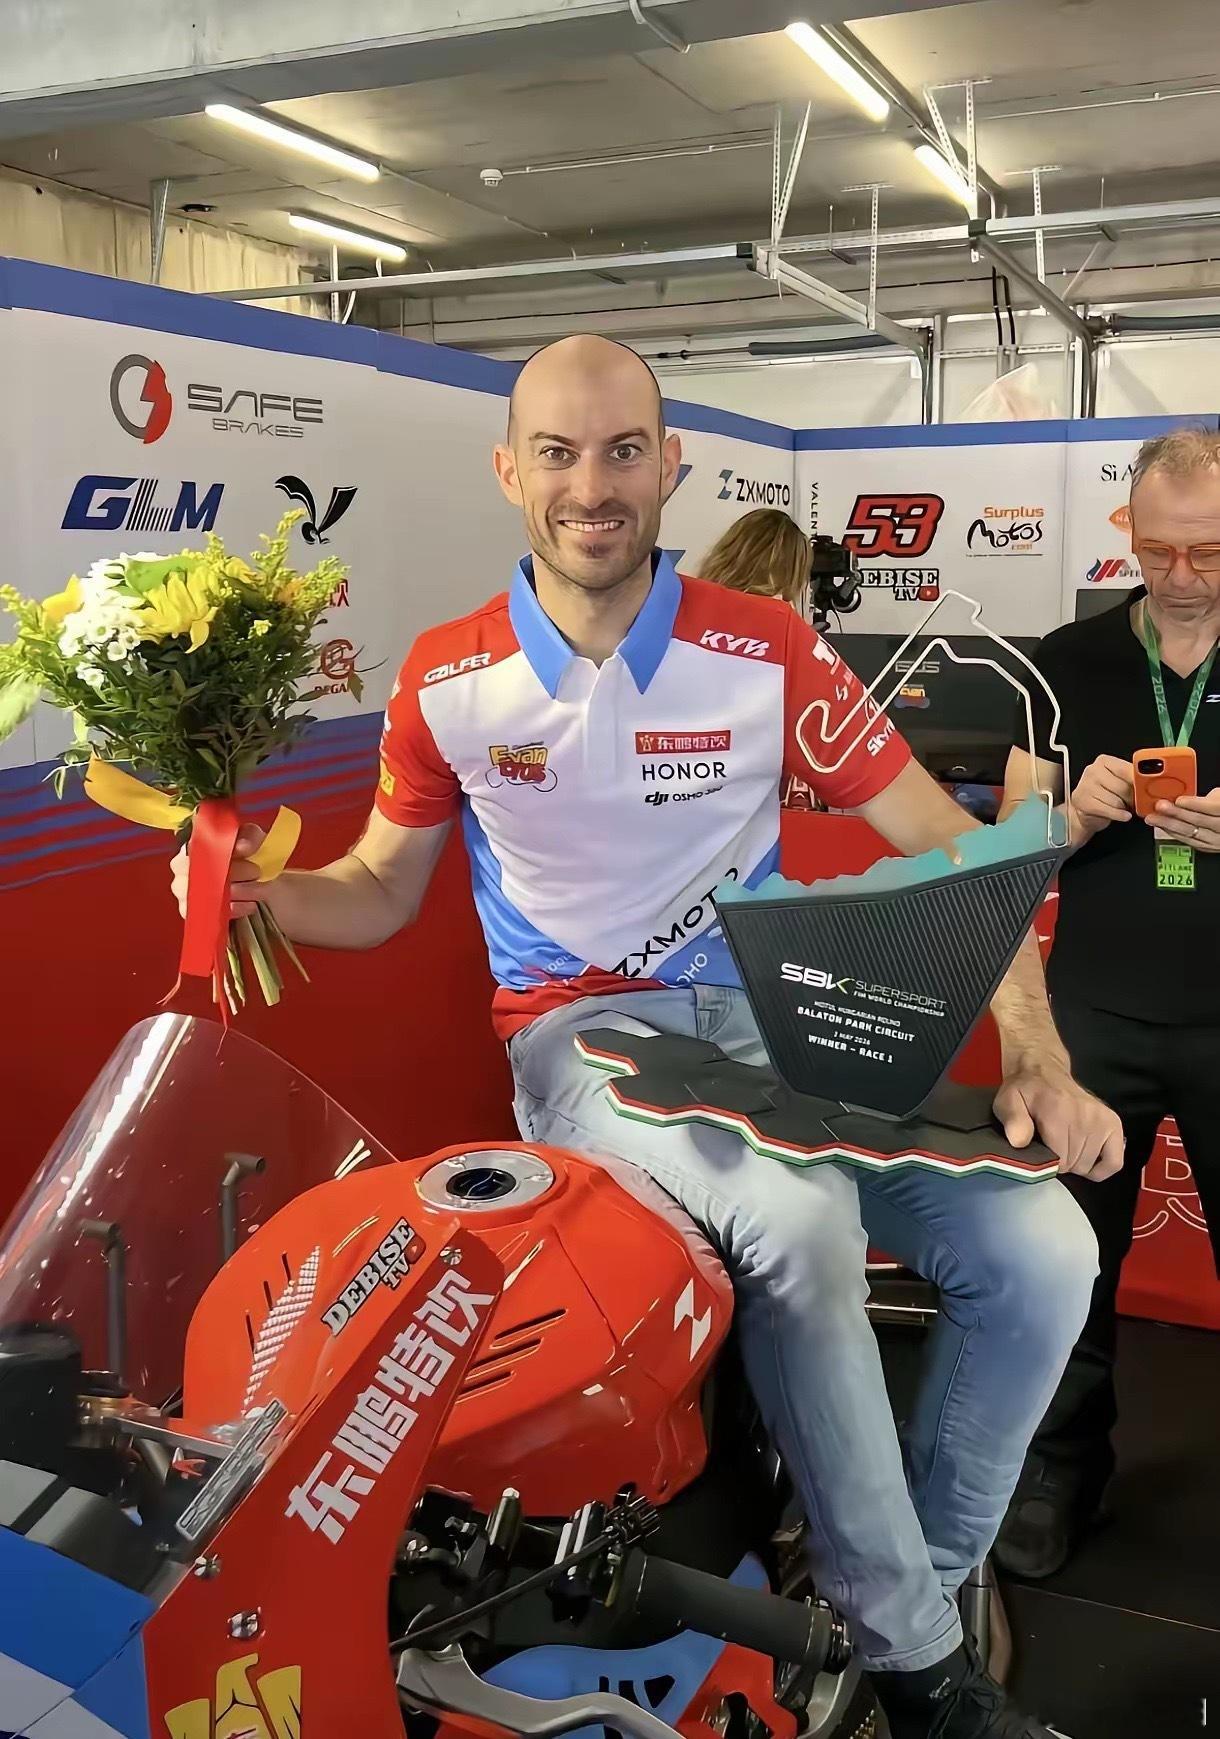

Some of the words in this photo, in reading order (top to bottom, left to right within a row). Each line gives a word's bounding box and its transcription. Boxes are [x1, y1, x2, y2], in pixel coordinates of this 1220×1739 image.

[188, 383, 324, 423] SAFE
[212, 418, 304, 438] BRAKES
[61, 475, 225, 532] GLM
[736, 477, 791, 506] ZXMOTO
[841, 493, 945, 558] 53
[983, 505, 1045, 521] Surplus
[966, 518, 1043, 549] Motos
[859, 568, 940, 588] EBISE
[423, 652, 492, 683] GALFER
[642, 761, 727, 781] HONOR
[1159, 874, 1193, 886] 2026
[780, 962, 856, 994] SBK
[855, 980, 947, 1010] SUPERSPORT
[868, 994, 893, 1005] WORLD
[797, 1006, 843, 1024] BALATON
[844, 1018, 873, 1032] PARK
[874, 1025, 915, 1042] CIRCUIT
[808, 1034, 847, 1051] WINNER
[859, 1047, 886, 1061] RACE
[321, 1216, 416, 1337] DEBISE
[381, 1251, 411, 1291] TV
